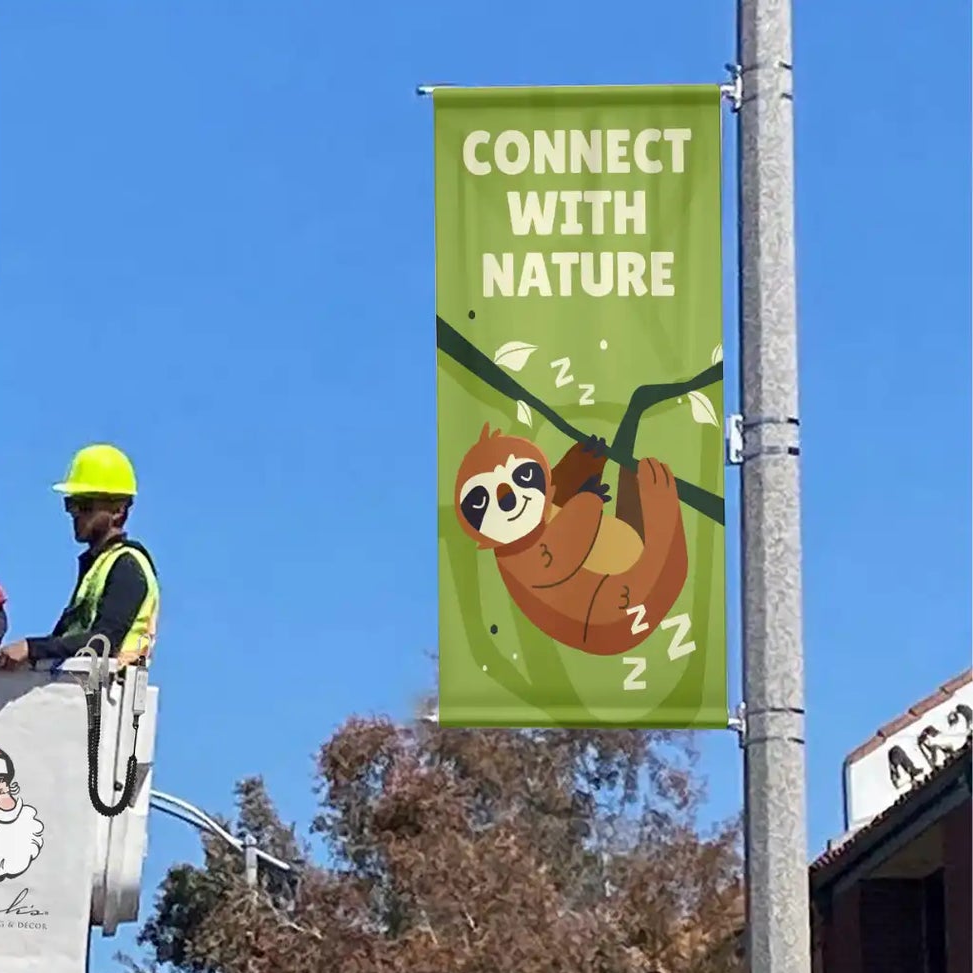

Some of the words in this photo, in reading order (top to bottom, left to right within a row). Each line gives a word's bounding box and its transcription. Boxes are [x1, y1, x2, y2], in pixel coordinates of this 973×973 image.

[462, 128, 692, 175] CONNECT
[506, 190, 647, 236] WITH
[482, 251, 675, 298] NATURE
[7, 921, 15, 929] &
